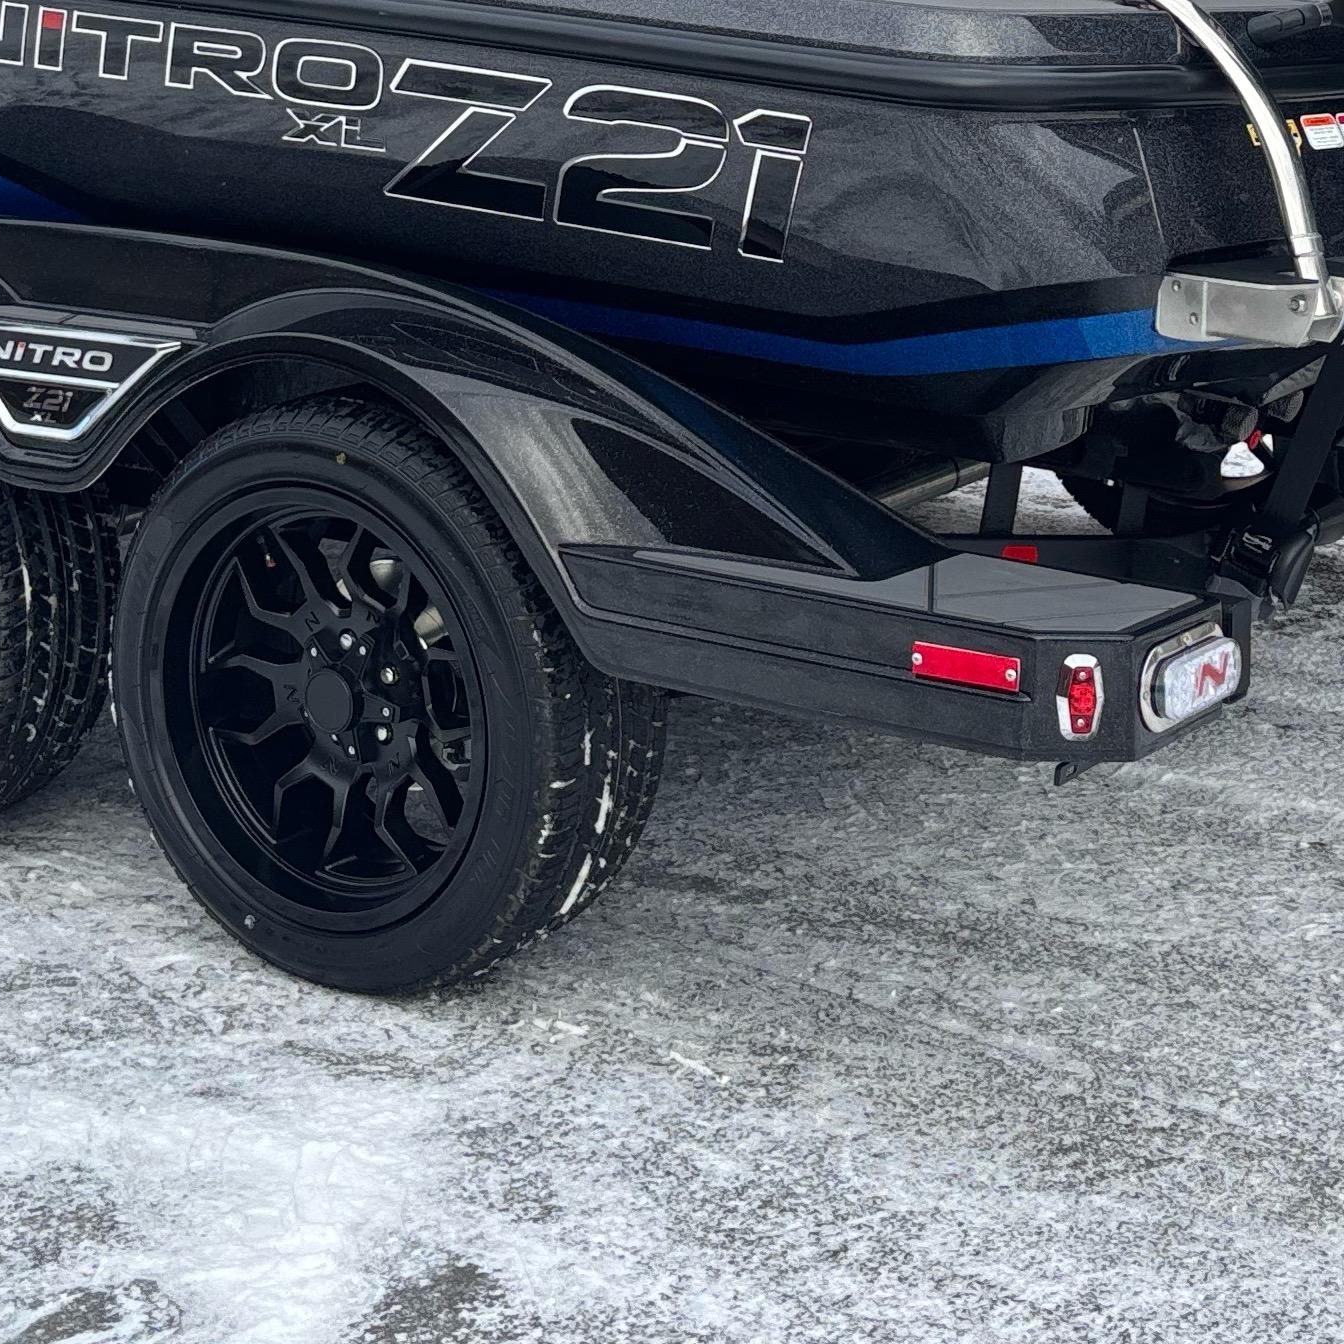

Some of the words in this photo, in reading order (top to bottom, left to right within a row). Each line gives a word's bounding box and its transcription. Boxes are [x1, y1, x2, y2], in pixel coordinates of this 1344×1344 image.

[281, 107, 387, 153] XL
[383, 57, 814, 264] Z21
[22, 386, 74, 414] Z21
[29, 410, 57, 424] XL
